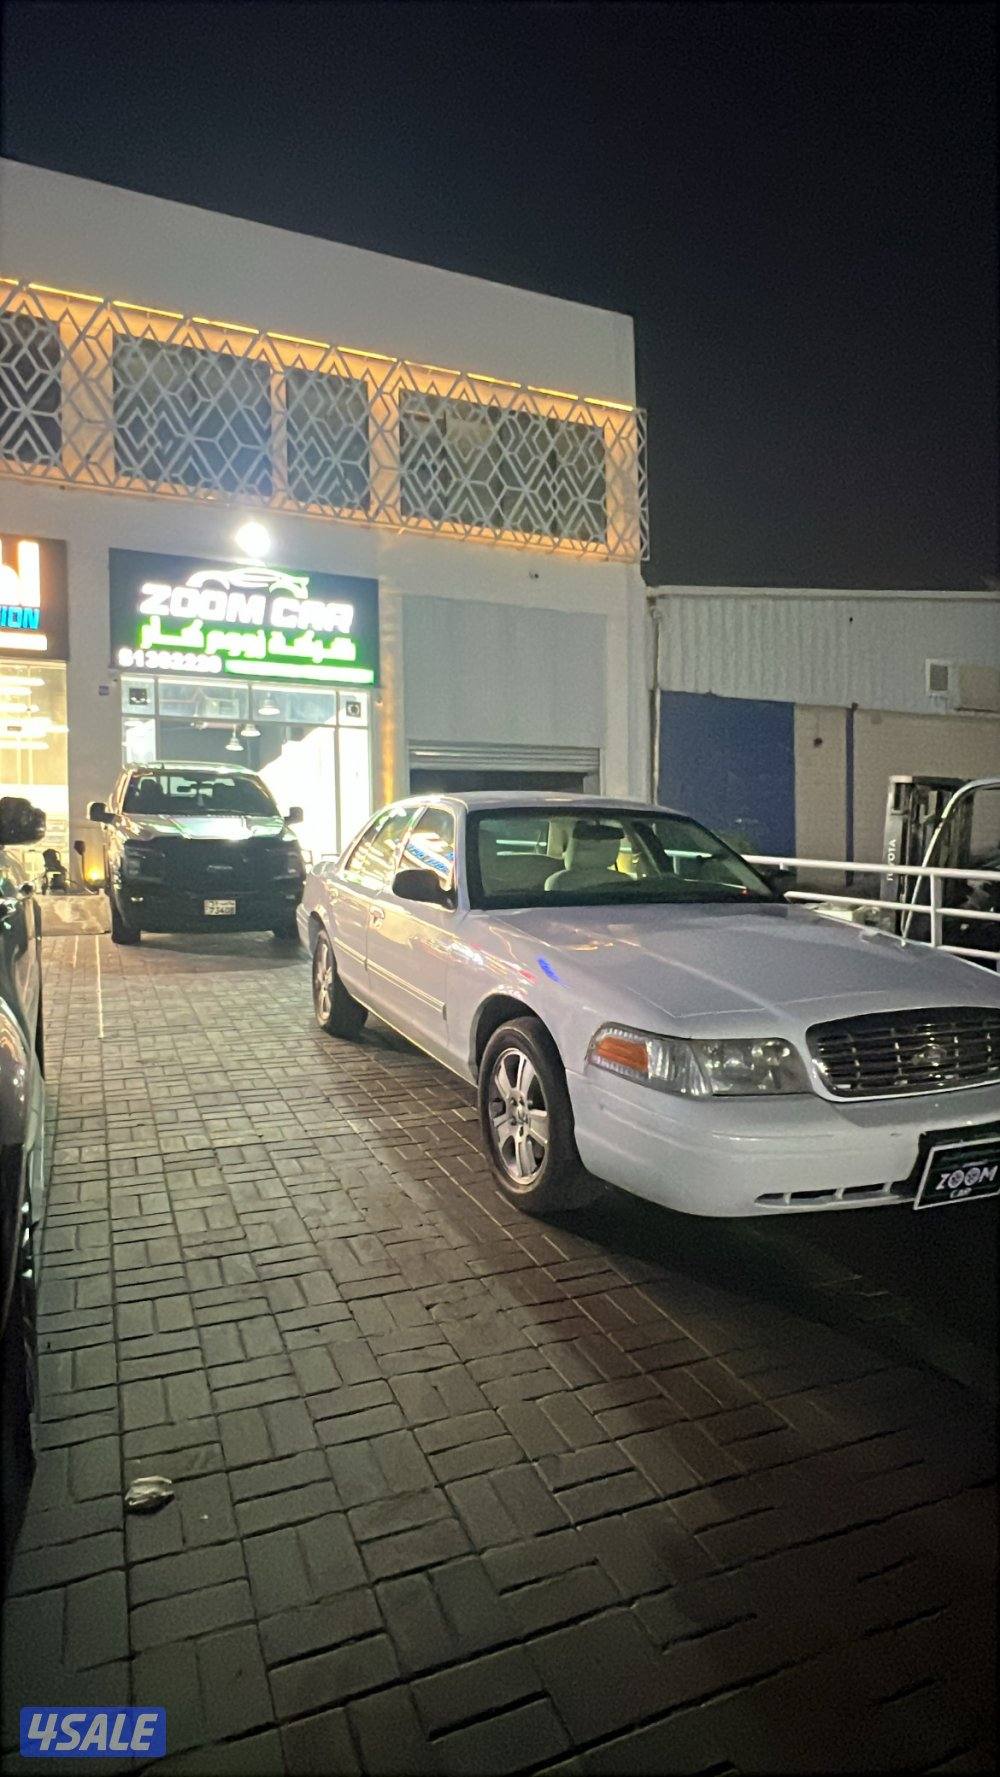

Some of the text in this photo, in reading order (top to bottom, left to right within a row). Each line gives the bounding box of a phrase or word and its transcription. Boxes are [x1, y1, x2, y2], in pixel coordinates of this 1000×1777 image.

[0, 605, 40, 629] ION
[139, 582, 354, 634] ZOOM CAR
[936, 1165, 998, 1191] ZOOM
